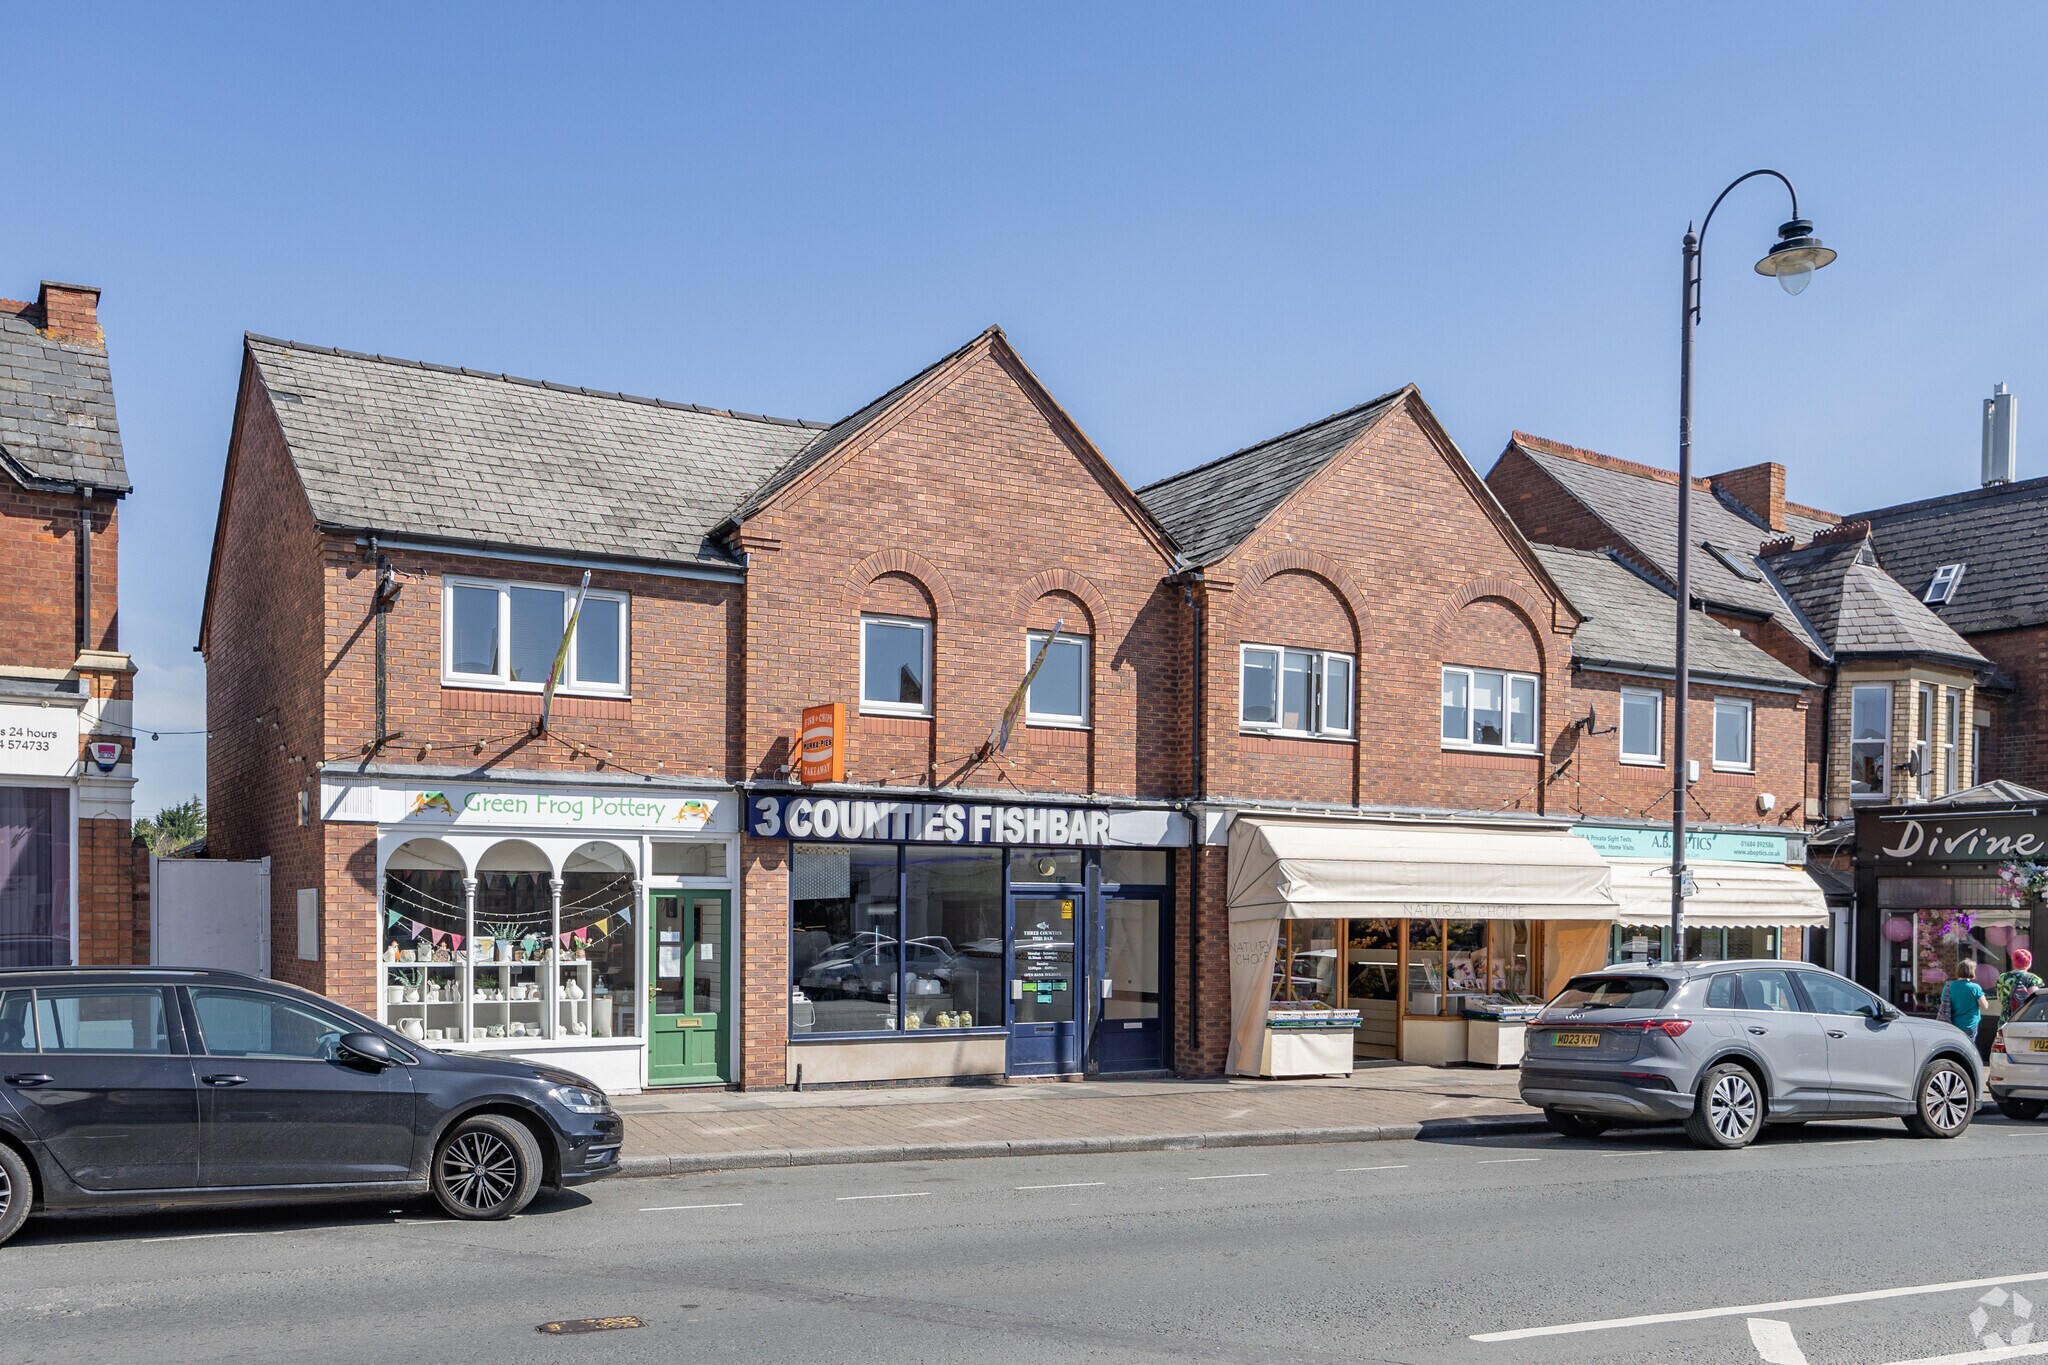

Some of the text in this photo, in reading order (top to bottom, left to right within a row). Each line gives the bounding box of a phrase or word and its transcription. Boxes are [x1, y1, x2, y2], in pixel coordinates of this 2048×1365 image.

[9, 726, 23, 737] 24
[26, 727, 58, 739] hours
[8, 739, 50, 751] 574733
[804, 763, 830, 776] TAKEAWAY
[464, 792, 666, 823] Green Frog Pottery
[754, 796, 781, 837] 3
[784, 798, 966, 844] COUNTIES
[1590, 834, 1606, 842] Private
[1607, 834, 1619, 843] Sight
[1620, 835, 1632, 843] Tests
[1652, 835, 1712, 851] A.B. PTICS
[1882, 820, 2045, 858] Divine
[1403, 904, 1526, 918] NATURAL CHOICE
